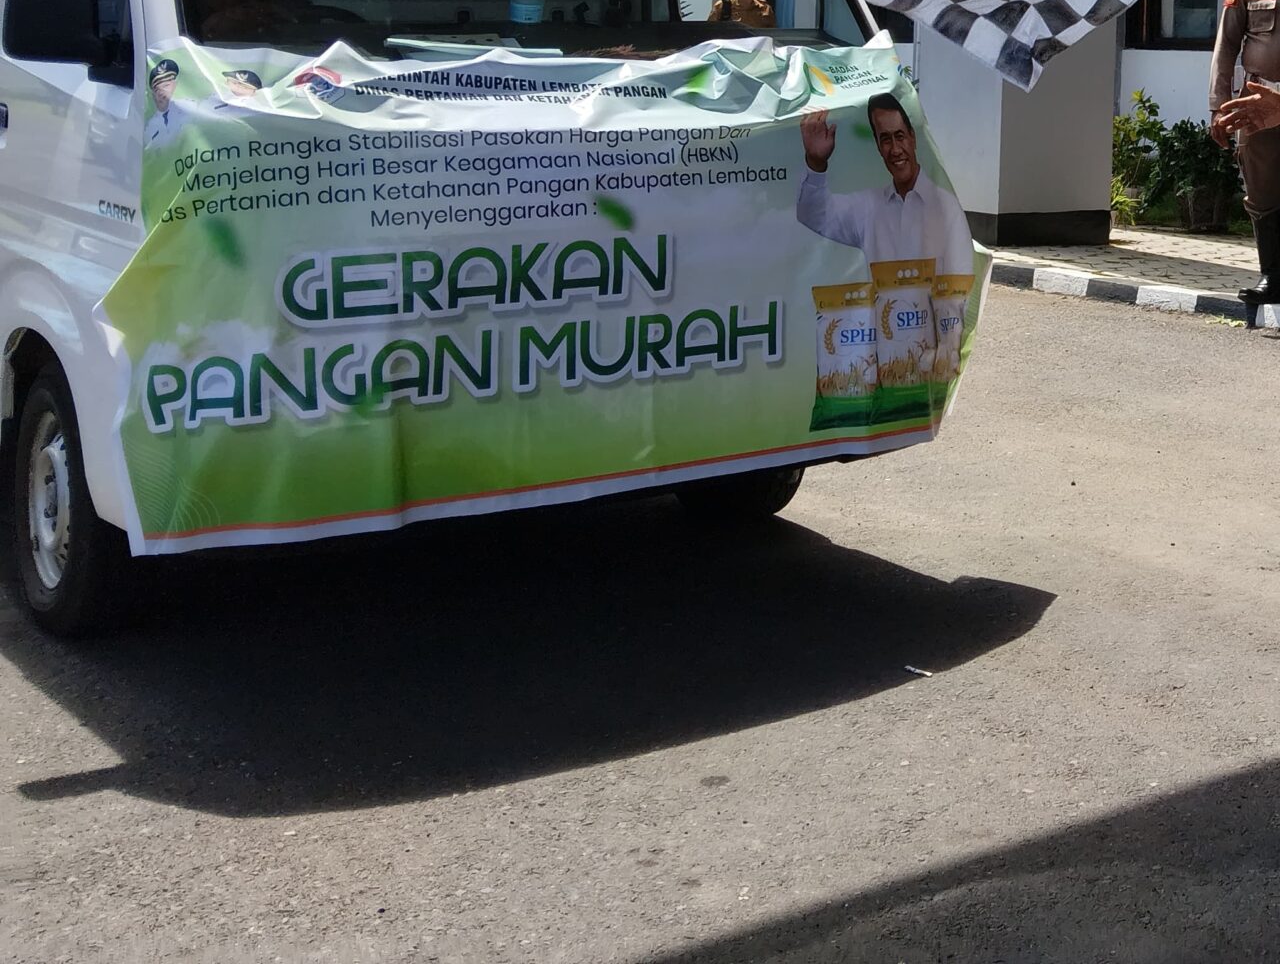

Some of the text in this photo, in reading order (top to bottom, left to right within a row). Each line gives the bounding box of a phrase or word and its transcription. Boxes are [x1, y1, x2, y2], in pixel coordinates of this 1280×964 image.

[375, 71, 602, 93] RINTAH KABUPATEN LEMBAT
[830, 65, 860, 74] BADAN
[834, 70, 873, 84] PANGAN
[841, 74, 889, 90] NASIONAL
[613, 85, 668, 99] PANGAN
[174, 125, 751, 177] Dalam Rangka Stabilisasi Pasokan Harga Pangan Dan
[182, 141, 739, 191] Menjelang Hari Besar Keagamaan Nasional (HBKN)
[192, 189, 310, 217] Pertanian
[317, 185, 366, 204] dan
[373, 180, 501, 201] Ketahanan
[507, 177, 590, 198] Pangan
[595, 172, 703, 193] Kabupaten
[708, 166, 788, 185] Lembata
[98, 199, 137, 224] CARRY
[371, 200, 587, 230] Menyelenggarakan
[281, 234, 667, 321] GERAKAN
[896, 309, 929, 328] SPHP
[146, 300, 778, 426] PANGAN MURAH
